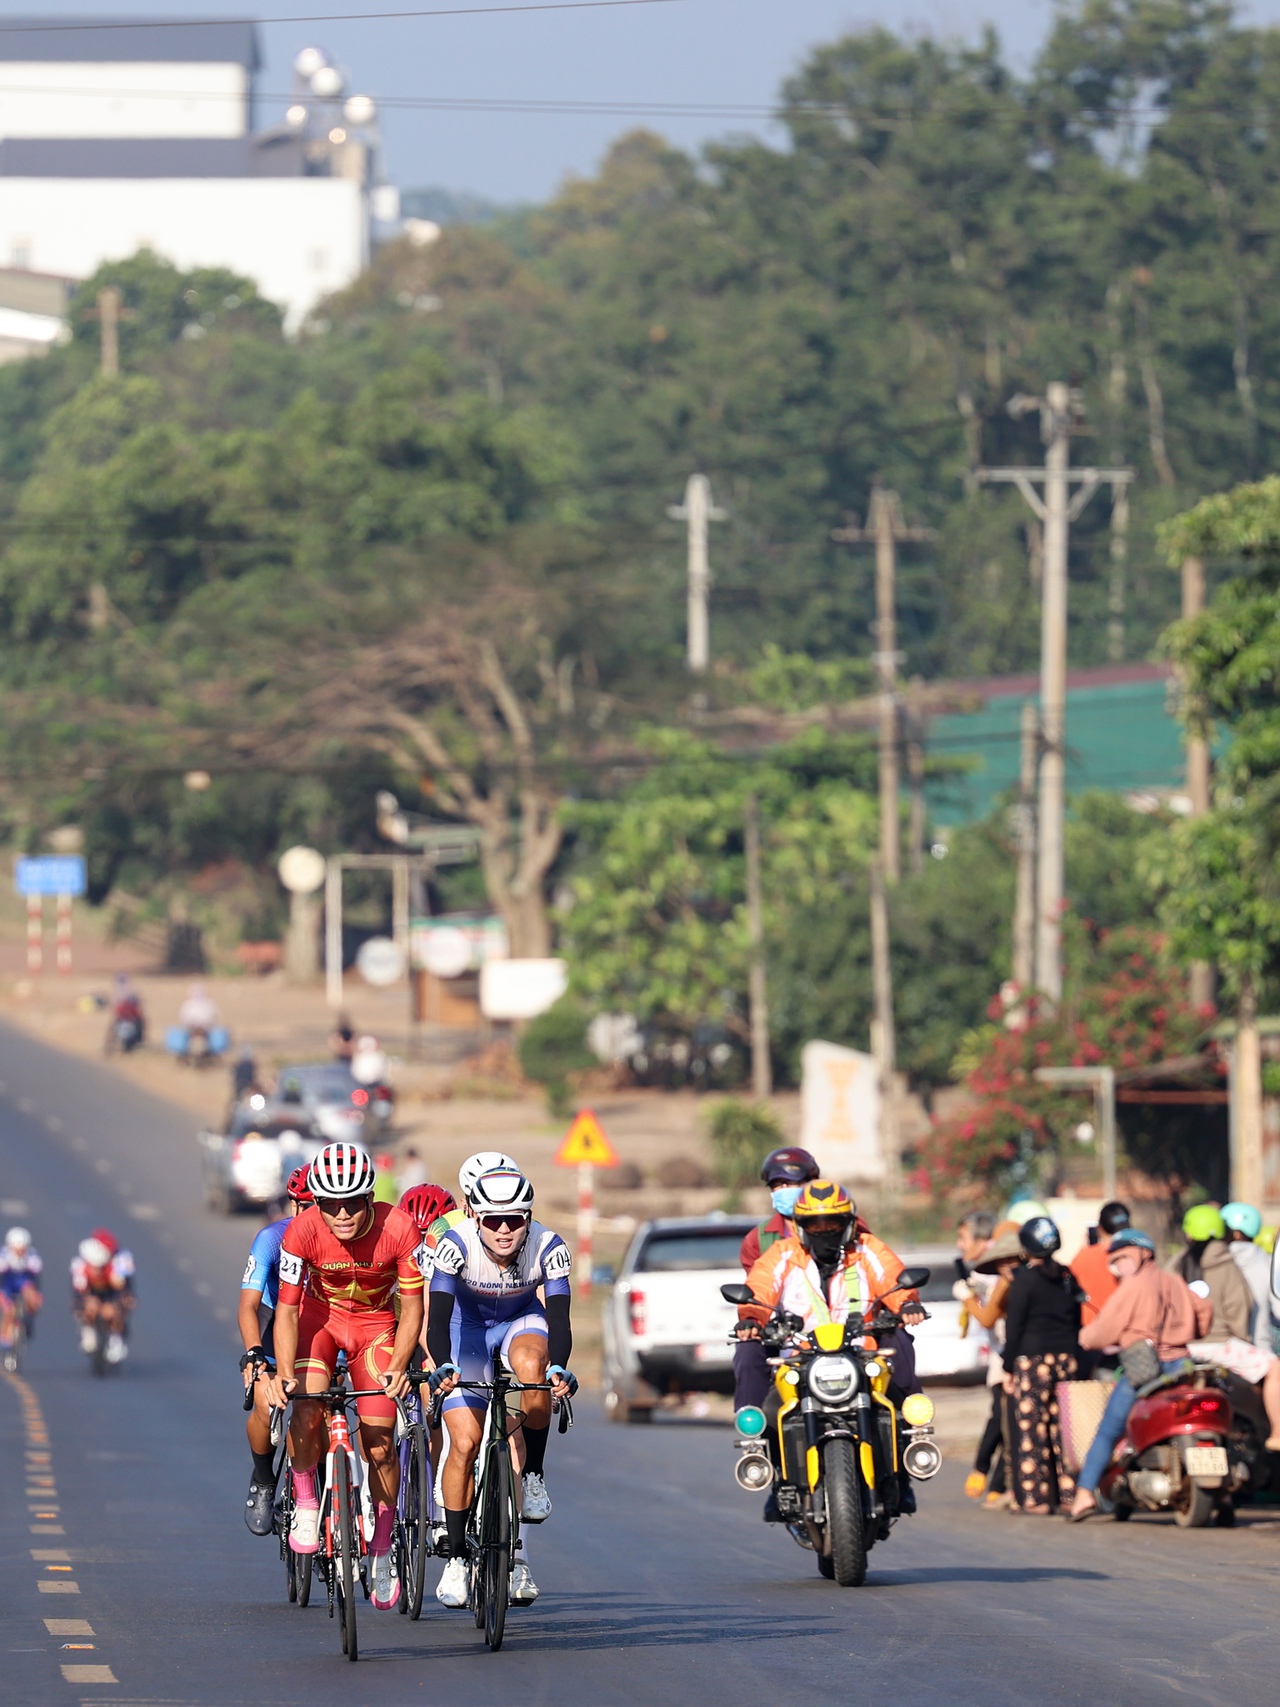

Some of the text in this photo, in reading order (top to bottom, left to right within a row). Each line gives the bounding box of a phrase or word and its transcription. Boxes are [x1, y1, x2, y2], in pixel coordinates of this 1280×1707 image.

[281, 1256, 298, 1275] 24
[436, 1243, 462, 1271] 104
[547, 1249, 571, 1271] 104
